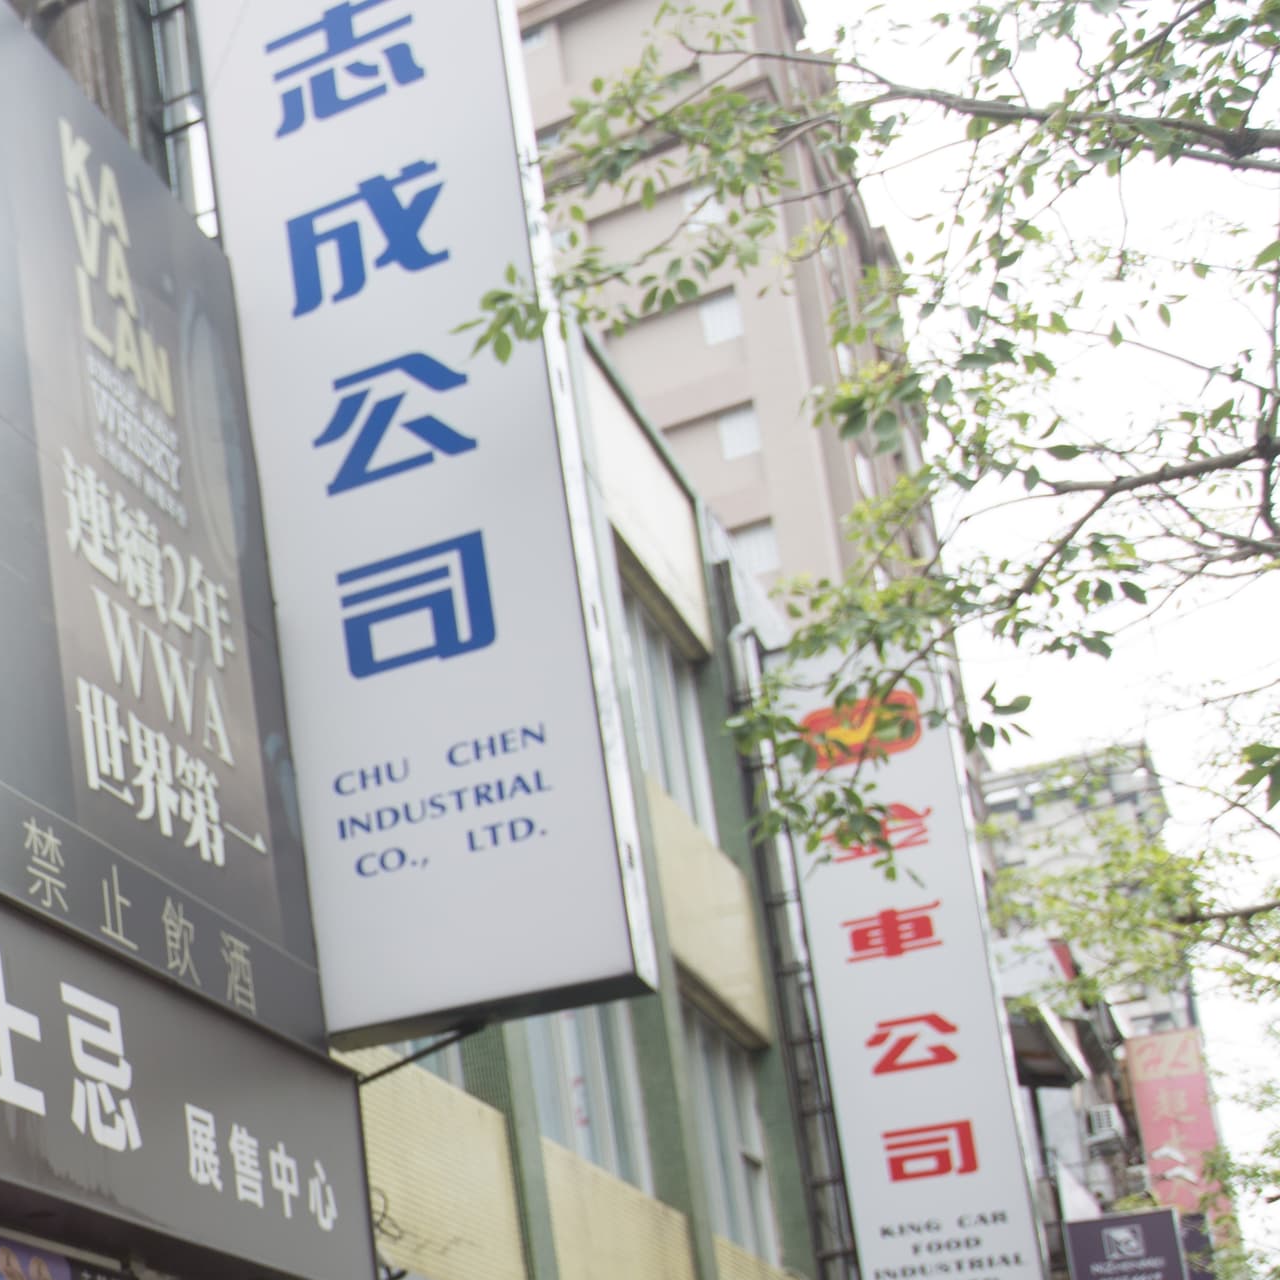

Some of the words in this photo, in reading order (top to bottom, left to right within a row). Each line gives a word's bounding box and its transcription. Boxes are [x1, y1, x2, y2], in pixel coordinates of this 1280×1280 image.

[265, 0, 497, 680] 志成公司
[61, 445, 238, 669] 連續2年
[90, 583, 237, 766] WWA
[74, 675, 269, 869] 世界第一
[332, 758, 410, 796] CHU
[446, 722, 547, 768] CHEN
[337, 769, 552, 841] INDUSTRIAL
[354, 847, 429, 878] CO.,
[466, 816, 548, 852] LTD.
[183, 1101, 338, 1232] 展售中心
[880, 1218, 942, 1238] KING
[957, 1210, 1008, 1229] CAR
[912, 1236, 982, 1255] FOOD
[874, 1251, 1026, 1280] INDUSTRIAL
